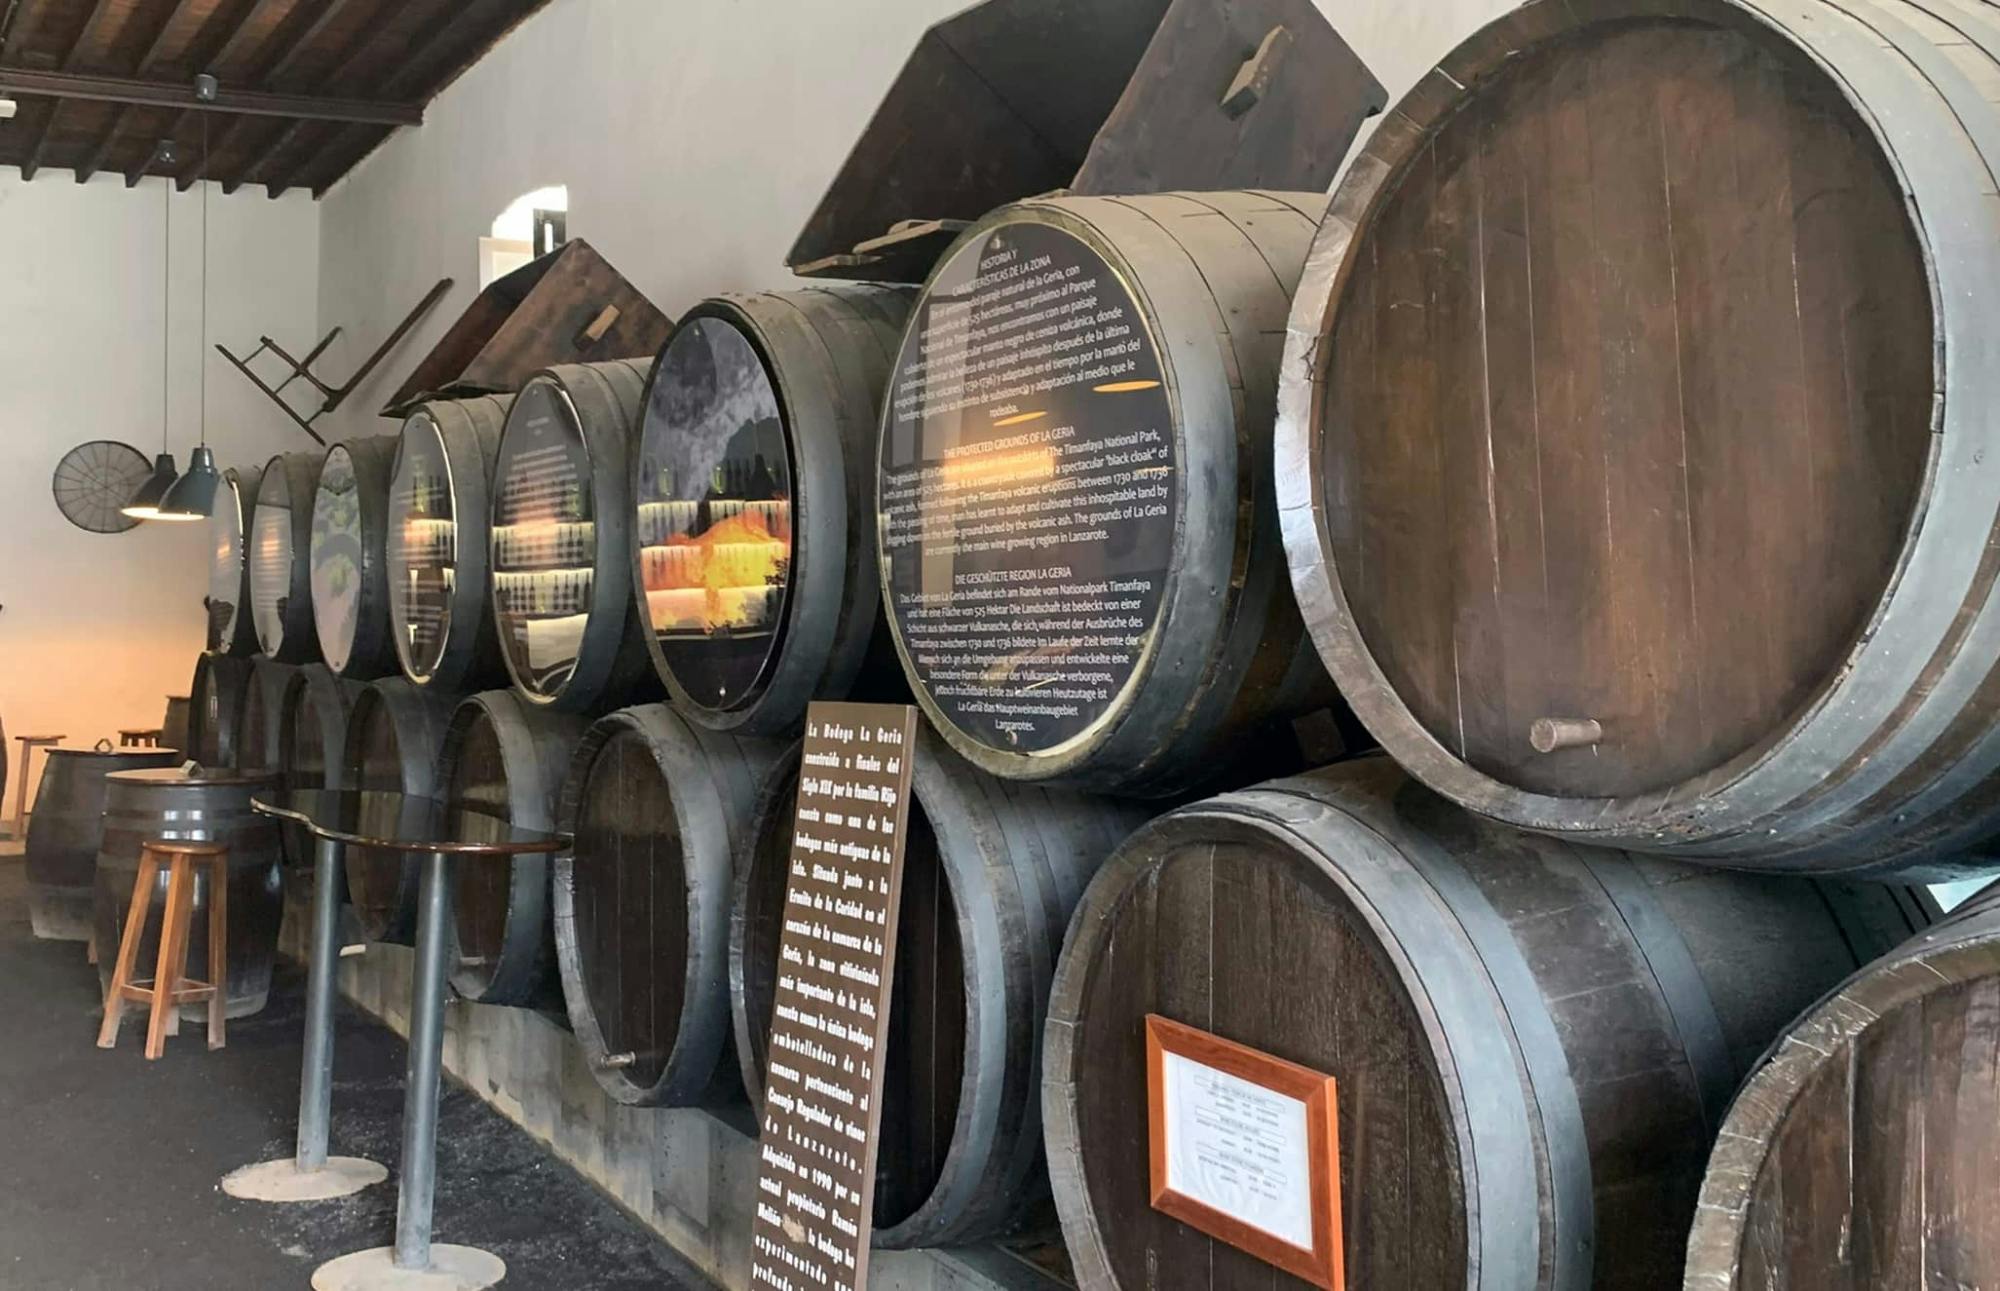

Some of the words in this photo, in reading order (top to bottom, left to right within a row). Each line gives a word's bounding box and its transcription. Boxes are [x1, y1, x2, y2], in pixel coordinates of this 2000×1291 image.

[981, 251, 1011, 269] HISTORIA
[1009, 265, 1019, 277] DE
[1020, 263, 1029, 274] LA
[1030, 255, 1051, 270] ZONA
[1002, 280, 1025, 296] natural
[1026, 279, 1035, 289] de
[1036, 276, 1043, 286] la
[1065, 266, 1080, 277] con
[1030, 290, 1060, 307] próximo
[1061, 284, 1067, 296] al
[1069, 279, 1096, 293] Parque
[1045, 307, 1059, 318] con
[1060, 304, 1070, 314] un
[1071, 296, 1097, 314] paisaje
[1004, 335, 1024, 348] negro
[1025, 331, 1034, 341] de
[1035, 325, 1058, 338] ceniza
[1059, 316, 1096, 331] volcánica,
[1097, 308, 1122, 322] donde
[1053, 335, 1084, 351] después
[1085, 332, 1095, 343] de
[1096, 330, 1103, 340] la
[1105, 325, 1130, 338] última
[1052, 356, 1079, 369] tiempo
[1080, 352, 1094, 366] por
[1095, 348, 1102, 359] la
[1127, 339, 1140, 351] del
[1076, 370, 1084, 381] al
[1085, 365, 1109, 379] medio
[1111, 363, 1126, 376] que
[1127, 360, 1135, 370] le
[956, 441, 993, 455] PROTECTED
[994, 434, 1029, 449] GROUNDS
[1030, 432, 1040, 443] OF
[1041, 430, 1051, 441] LA
[1051, 426, 1075, 439] GERIA
[1064, 440, 1103, 454] Timanfaya
[1104, 432, 1138, 448] National
[1140, 429, 1161, 442] Park,
[1061, 457, 1104, 475] spectacular
[1158, 446, 1168, 458] of
[1077, 476, 1112, 488] between
[1113, 473, 1131, 485] 1730
[1073, 496, 1087, 506] this
[1088, 488, 1137, 504] inhospitable
[1138, 485, 1156, 498] land
[1157, 485, 1168, 499] by
[1074, 513, 1088, 523] The
[1089, 508, 1122, 526] grounds
[1123, 506, 1132, 519] of
[1134, 507, 1144, 517] La
[1145, 503, 1167, 516] Geria
[1036, 534, 1059, 547] region
[1060, 532, 1068, 542] in
[1068, 530, 1109, 542] Lanzarote.
[955, 574, 966, 584] DIE
[967, 571, 1008, 584] GESCHÜTZTE
[1009, 570, 1037, 581] REGION
[1038, 569, 1048, 579] LA
[1048, 567, 1072, 578] GERIA
[1060, 582, 1108, 596] Nationalpark
[1109, 579, 1151, 593] Timanfaya
[1021, 601, 1060, 613] Landschaft
[1072, 600, 1103, 611] bedeckt
[1104, 602, 1119, 610] von
[1121, 599, 1141, 609] einer
[1085, 617, 1127, 628] Ausbrüche
[1128, 616, 1143, 627] des
[1084, 636, 1099, 646] Zeit
[1100, 635, 1124, 646] lernte
[1067, 670, 1114, 684] verborgene,
[1052, 688, 1096, 702] Heutzutage
[1097, 688, 1107, 699] ist
[808, 723, 817, 736] La
[824, 724, 853, 743] Bodega
[861, 727, 869, 741] La
[878, 728, 901, 744] Geria
[805, 752, 839, 767] construida
[846, 759, 850, 768] a
[857, 754, 880, 771] finales
[887, 758, 899, 773] del
[803, 778, 820, 796] Siglo
[819, 780, 832, 796] XIX
[833, 784, 844, 799] por
[846, 782, 852, 797] la
[855, 783, 879, 801] familia
[825, 813, 842, 824] como
[848, 817, 861, 828] una
[867, 815, 876, 830] de
[882, 817, 893, 833] las
[796, 832, 821, 853] bodegas
[824, 840, 837, 853] más
[840, 842, 869, 861] antiguas
[872, 846, 880, 861] de
[883, 847, 890, 863] la
[813, 864, 838, 883] Situada
[843, 871, 862, 889] junto
[869, 880, 873, 891] a
[880, 877, 887, 894] la
[790, 888, 811, 906] Ermita
[814, 894, 823, 909] de
[826, 896, 832, 912] la
[835, 899, 862, 918] Caridad
[865, 910, 874, 921] en
[878, 909, 885, 924] el
[786, 920, 811, 935] corazón
[813, 923, 821, 938] de
[823, 925, 830, 941] la
[832, 932, 861, 949] comarca
[863, 936, 872, 952] de
[874, 938, 882, 955] la
[783, 945, 802, 965] Geria,
[808, 951, 814, 966] la
[819, 959, 835, 973] zona
[780, 975, 794, 990] más
[797, 978, 834, 1003] importante
[837, 990, 846, 1007] de
[849, 993, 856, 1011] la
[860, 998, 875, 1019] isla,
[800, 1013, 817, 1027] como
[819, 1014, 826, 1031] la
[848, 1024, 873, 1051] bodega
[774, 1033, 836, 1066] embotelladora
[844, 1055, 853, 1072] de
[862, 1061, 870, 1080] la
[771, 1062, 799, 1082] comarca
[805, 1075, 853, 1104] perteneciente
[860, 1094, 868, 1111] al
[768, 1087, 794, 1113] Consejo
[797, 1099, 831, 1127] Regulador
[834, 1115, 843, 1132] de
[846, 1122, 865, 1142] vinos
[766, 1116, 777, 1134] de
[788, 1125, 861, 1174] Lanzarote.
[799, 1166, 808, 1178] en
[813, 1169, 832, 1190] 1990
[835, 1183, 847, 1199] por
[760, 1177, 781, 1196] actual
[787, 1190, 825, 1219] propietario
[832, 1209, 857, 1236] Ramón
[756, 1235, 826, 1284] experimentado
[809, 1228, 815, 1246] la
[818, 1233, 842, 1263] bodega
[845, 1249, 854, 1268] ha
